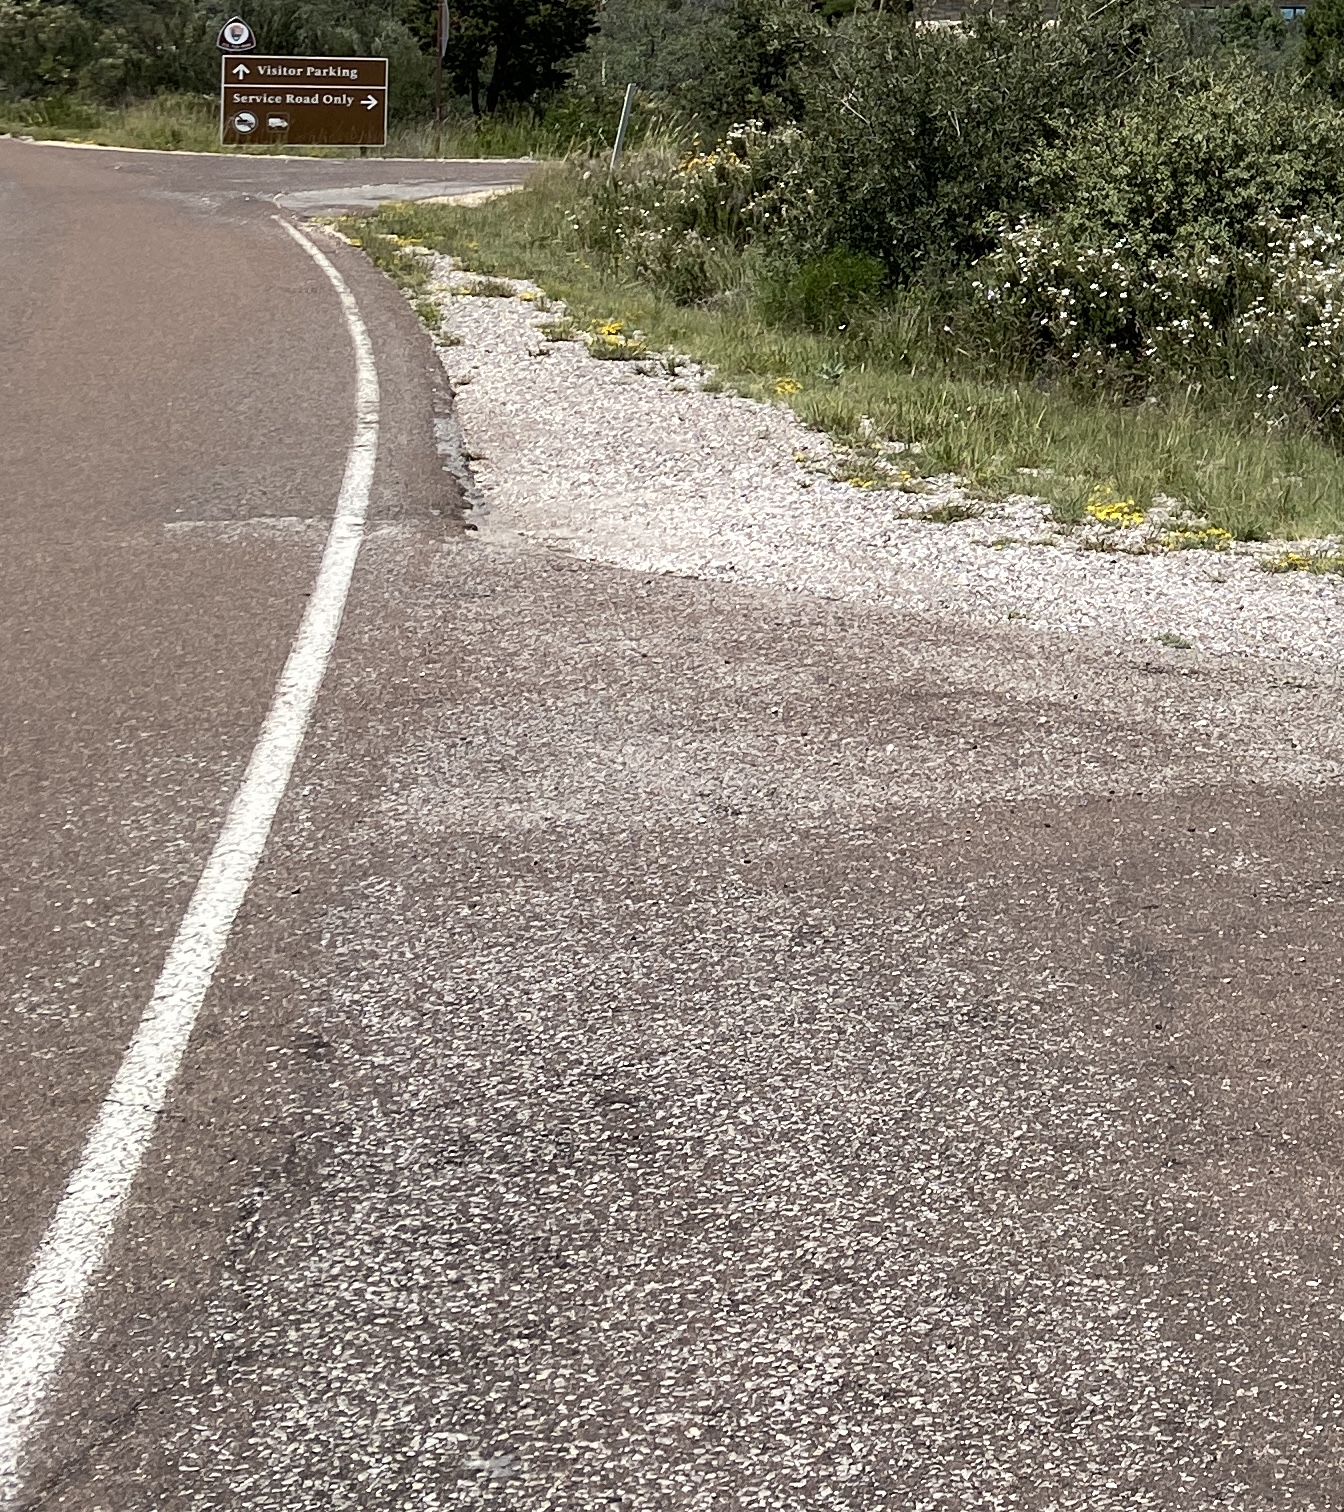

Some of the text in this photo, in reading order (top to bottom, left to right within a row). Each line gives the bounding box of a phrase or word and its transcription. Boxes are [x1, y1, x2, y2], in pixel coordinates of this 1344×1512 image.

[257, 65, 358, 79] Visitor Parking
[233, 93, 354, 106] Service Road Only
